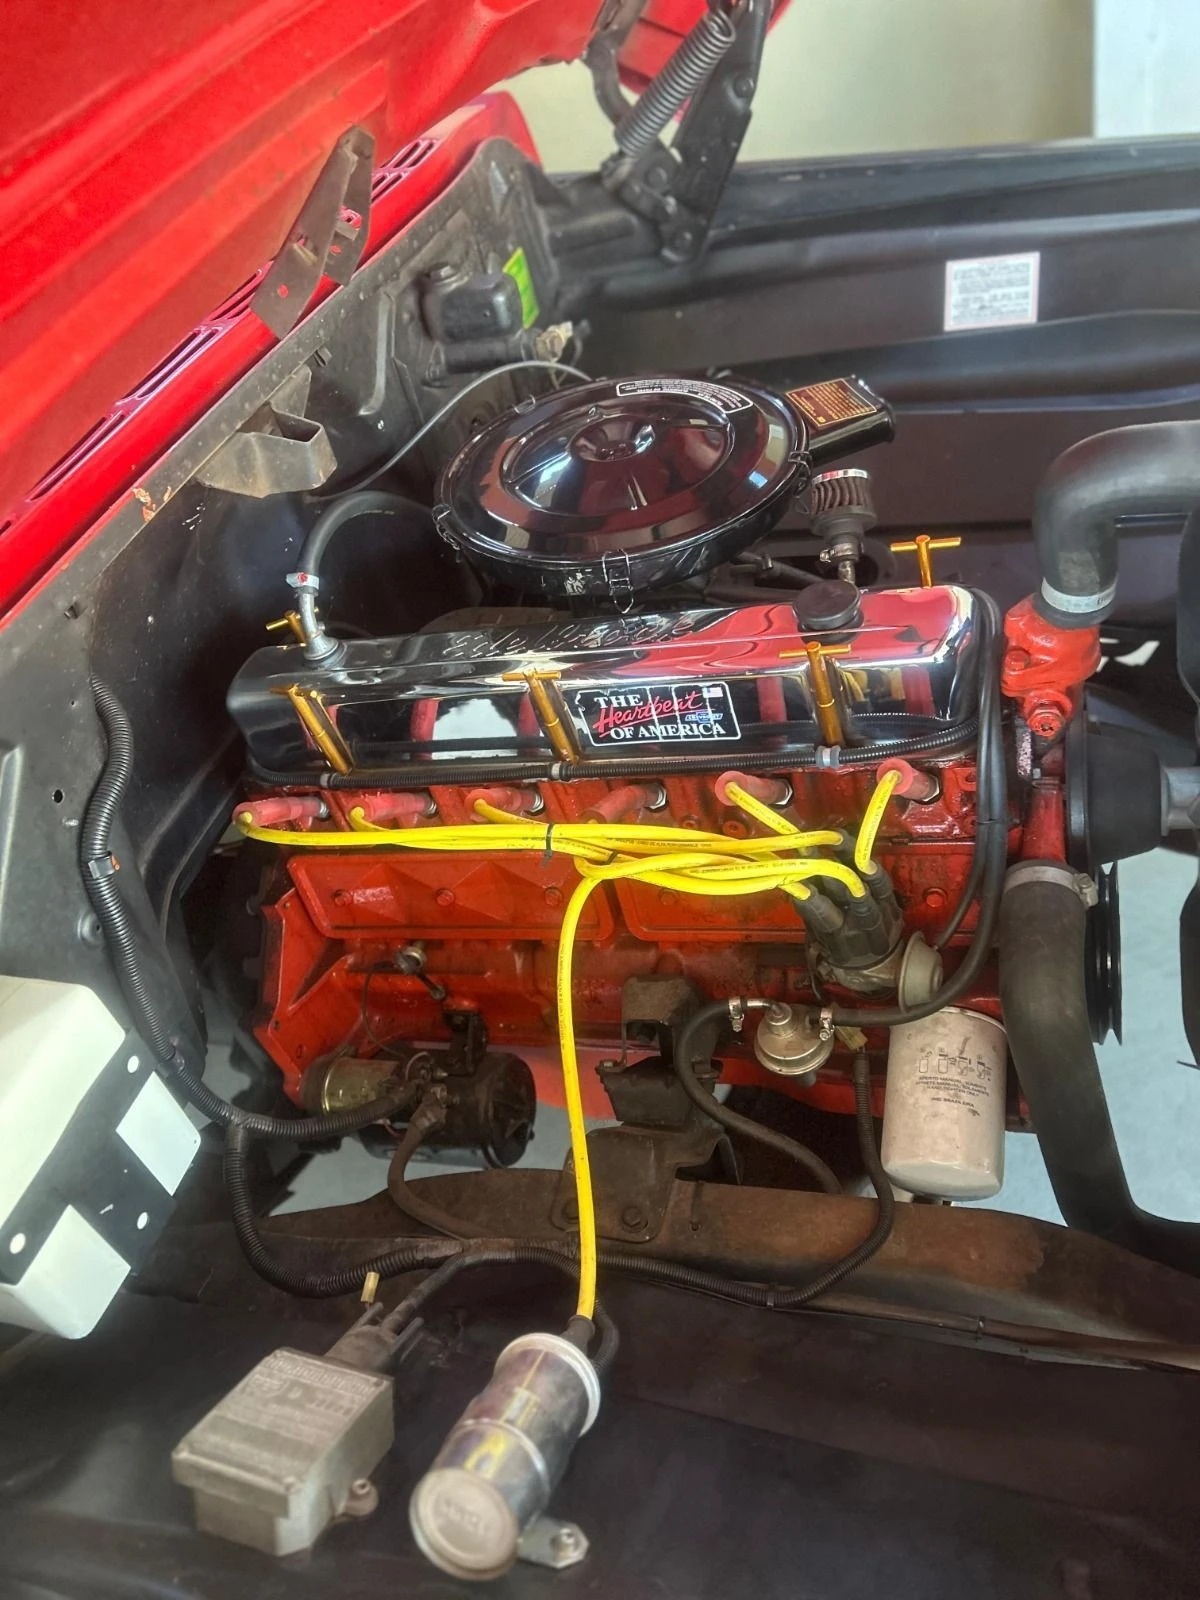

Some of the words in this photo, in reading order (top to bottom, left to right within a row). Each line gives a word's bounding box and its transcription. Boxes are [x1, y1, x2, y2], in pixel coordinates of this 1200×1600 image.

[594, 694, 643, 708] THE
[592, 691, 704, 732] Heartbeat
[610, 726, 634, 740] OF
[638, 723, 726, 739] AMERICA
